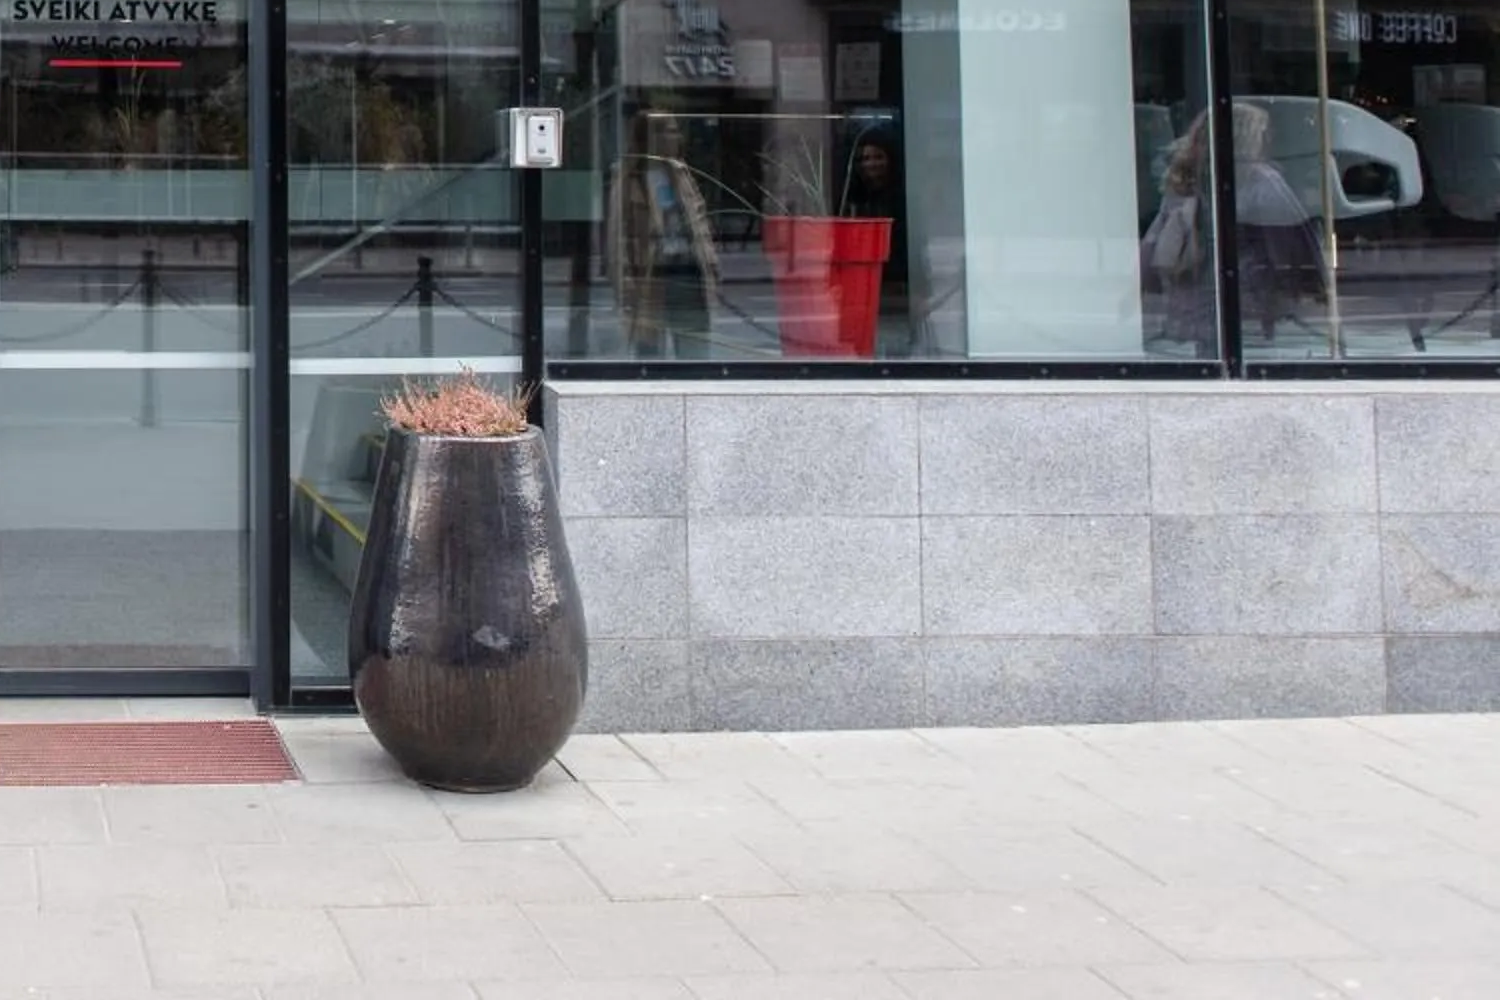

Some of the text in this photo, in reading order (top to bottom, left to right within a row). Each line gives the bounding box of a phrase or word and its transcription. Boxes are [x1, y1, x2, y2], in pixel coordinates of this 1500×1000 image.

[13, 0, 218, 28] SVEIKI ATVYKĘ
[51, 35, 180, 54] WELCOME
